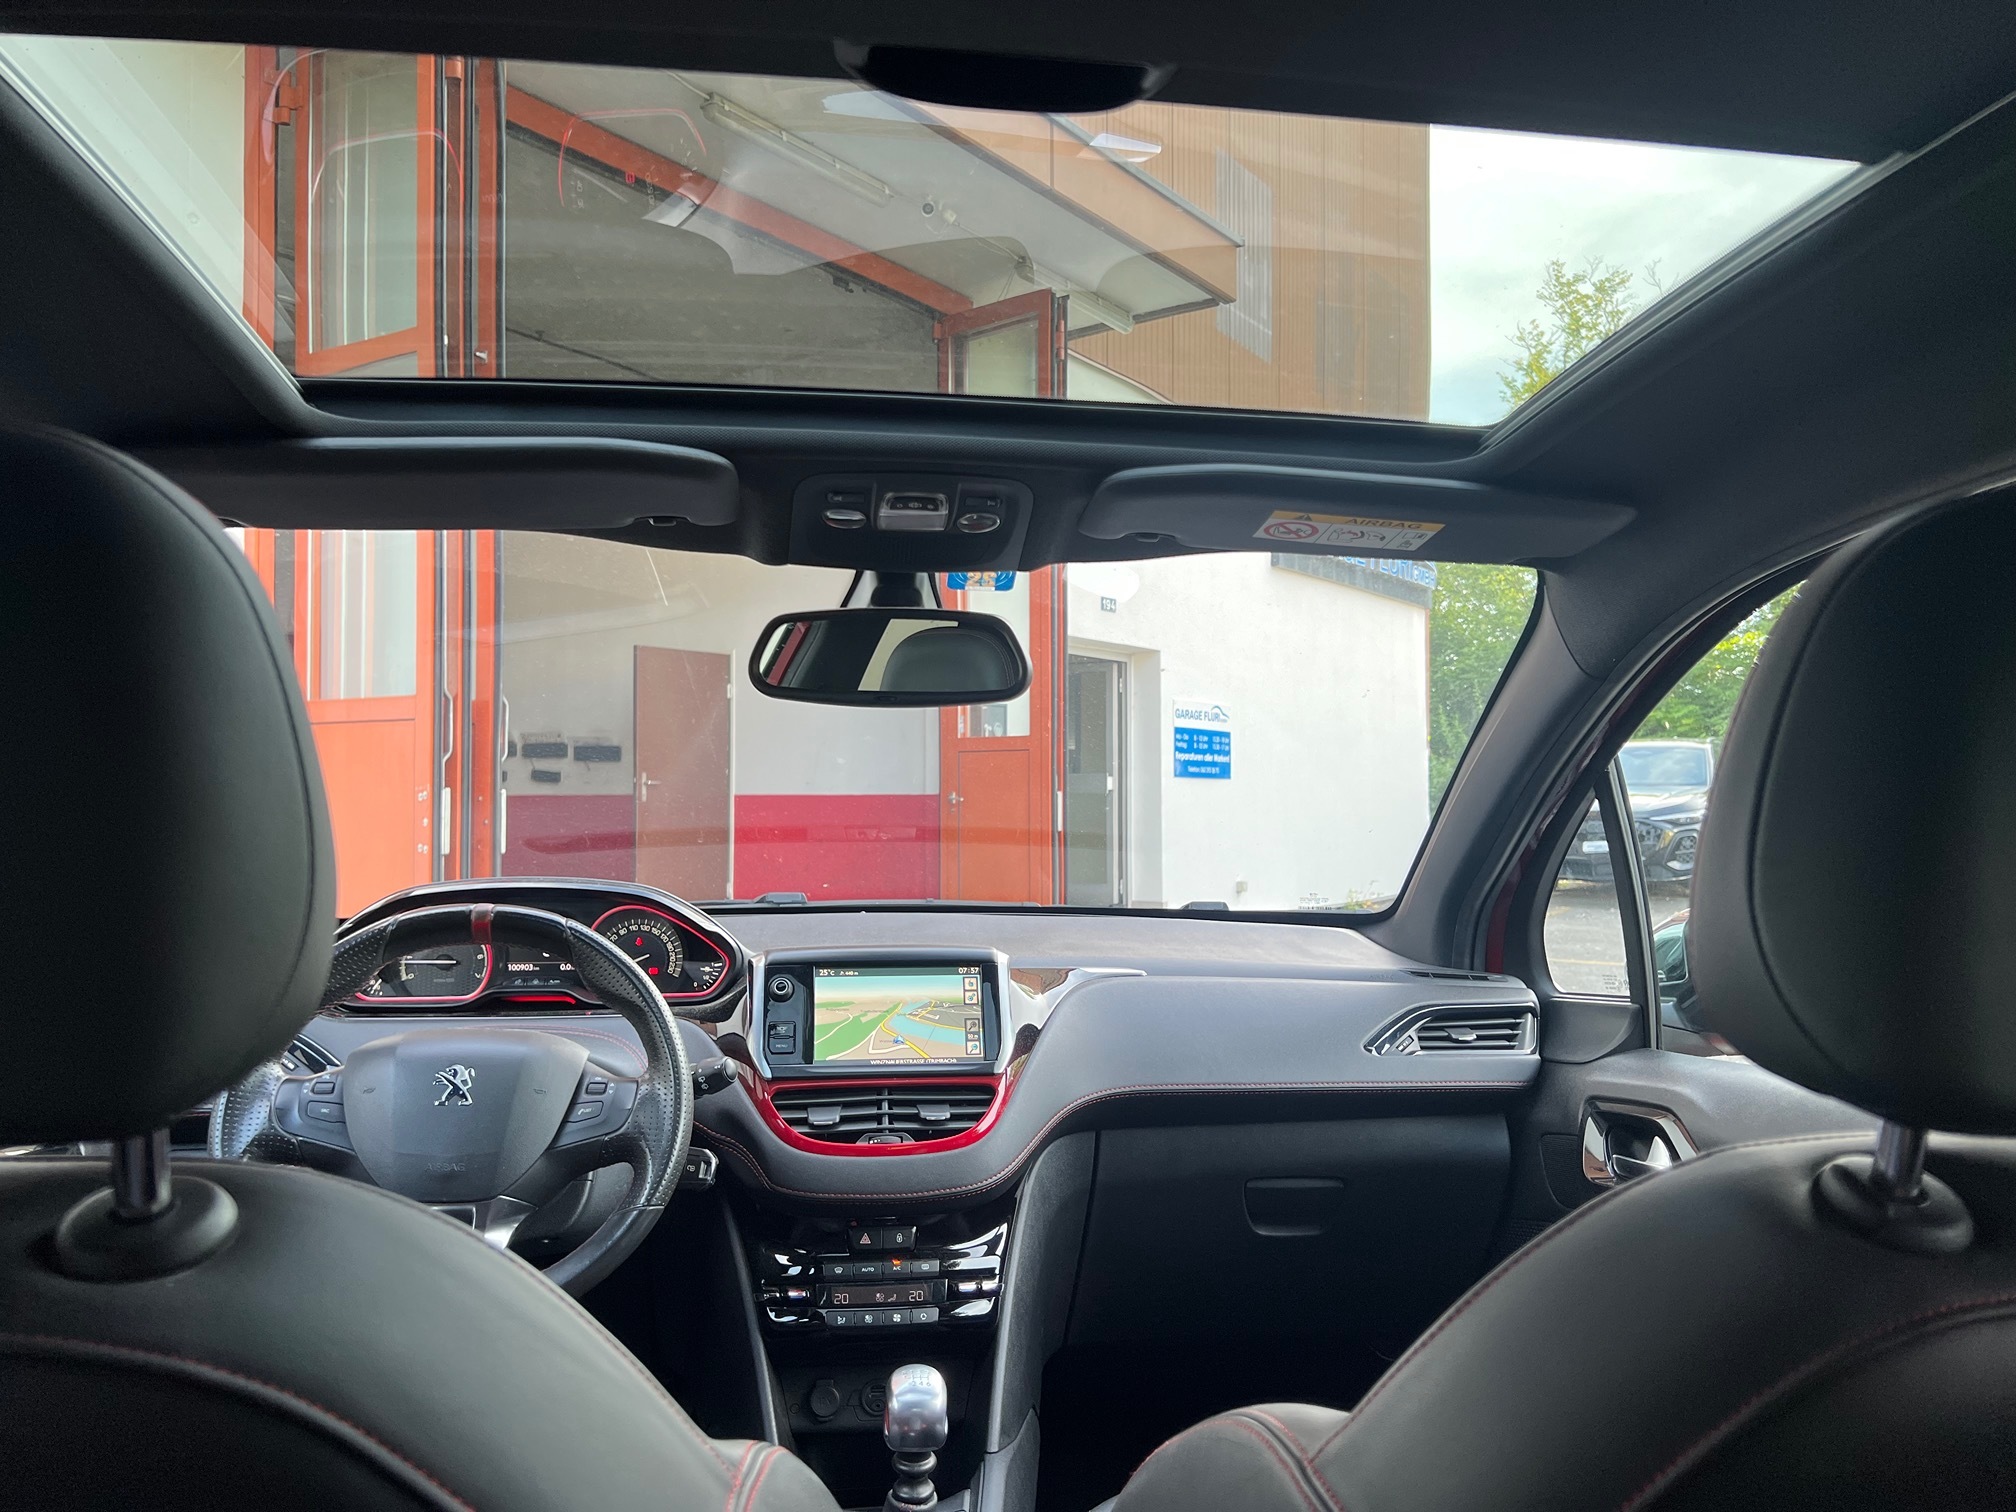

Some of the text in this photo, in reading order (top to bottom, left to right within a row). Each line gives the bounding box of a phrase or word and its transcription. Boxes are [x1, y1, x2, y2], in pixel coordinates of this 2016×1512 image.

[1345, 518, 1422, 529] AIRBAG
[1103, 598, 1115, 610] 194
[1175, 708, 1203, 721] GARAGE
[1204, 711, 1220, 722] FLURI
[640, 924, 651, 932] 130
[651, 927, 661, 936] 150
[660, 933, 669, 943] 170
[507, 963, 534, 971] 100903
[560, 963, 572, 971] 0.0
[424, 1162, 466, 1171] AIRBAG
[834, 1293, 849, 1304] 20
[908, 1290, 924, 1301] 20
